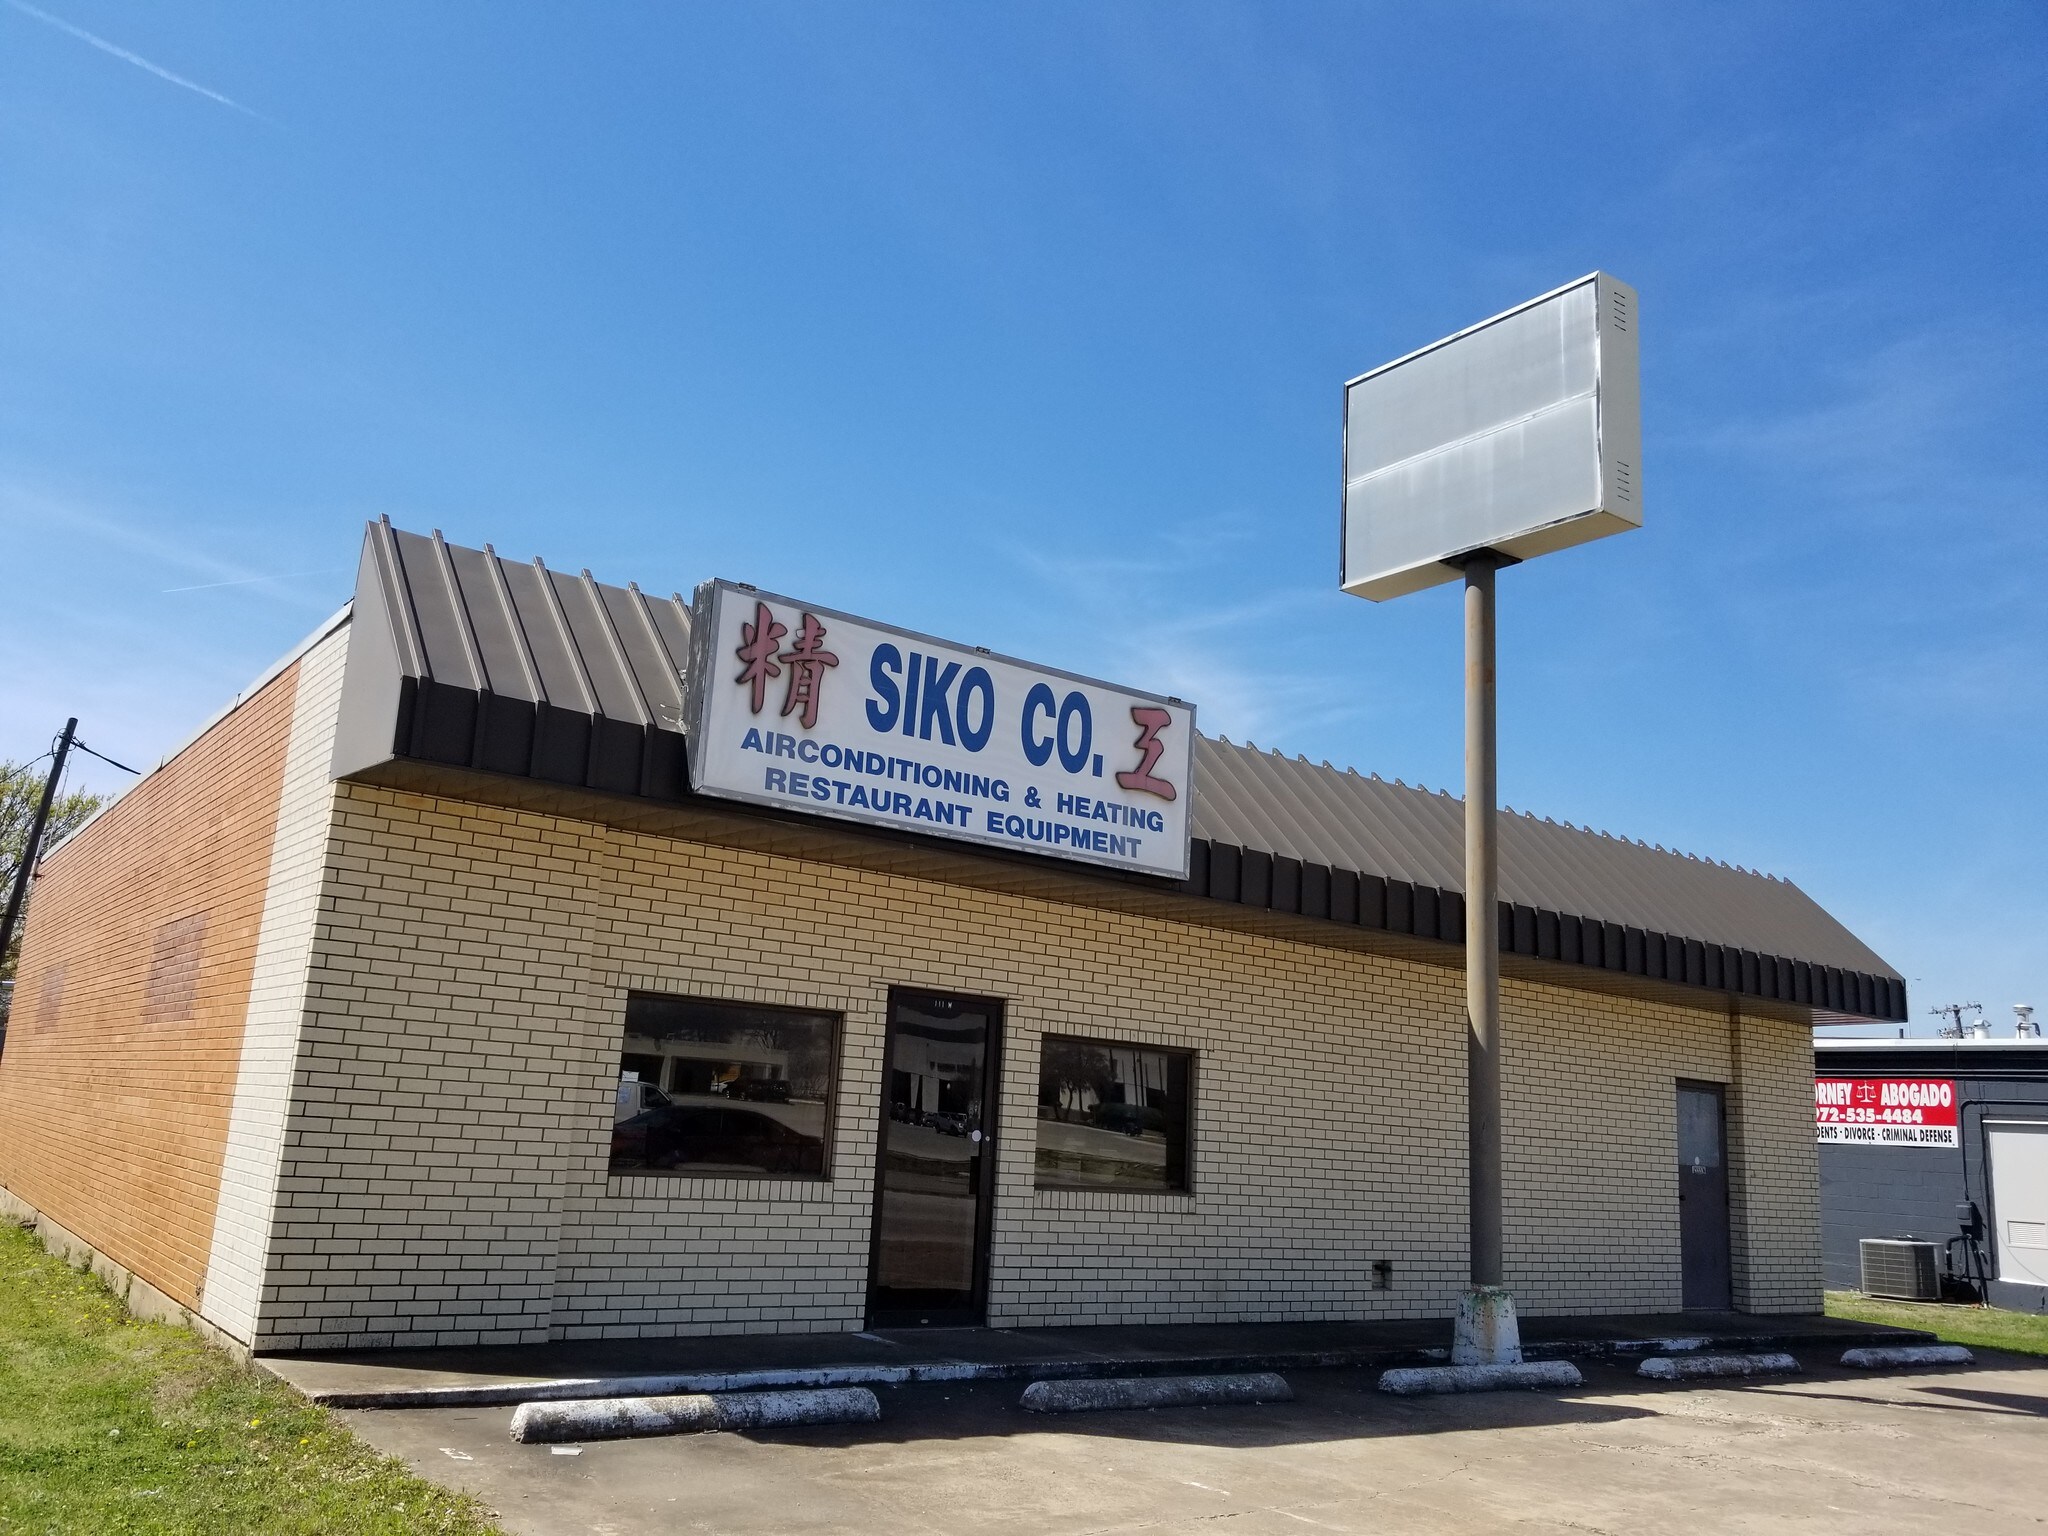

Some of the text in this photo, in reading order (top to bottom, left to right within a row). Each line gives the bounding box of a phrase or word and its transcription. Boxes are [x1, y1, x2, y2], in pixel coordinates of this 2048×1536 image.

[735, 602, 839, 730] 精
[865, 643, 1104, 778] SIKO CO.
[740, 728, 1164, 832] AIRCONDITIONING & HEATING
[764, 767, 1142, 858] RESTAURANT EQUIPMENT
[1815, 1083, 1951, 1107] RNEY ABOGADO
[1844, 1127, 1875, 1140] DIVORCE
[1881, 1128, 1917, 1142] CRIMINAL
[1919, 1130, 1952, 1143] DEFENSE
